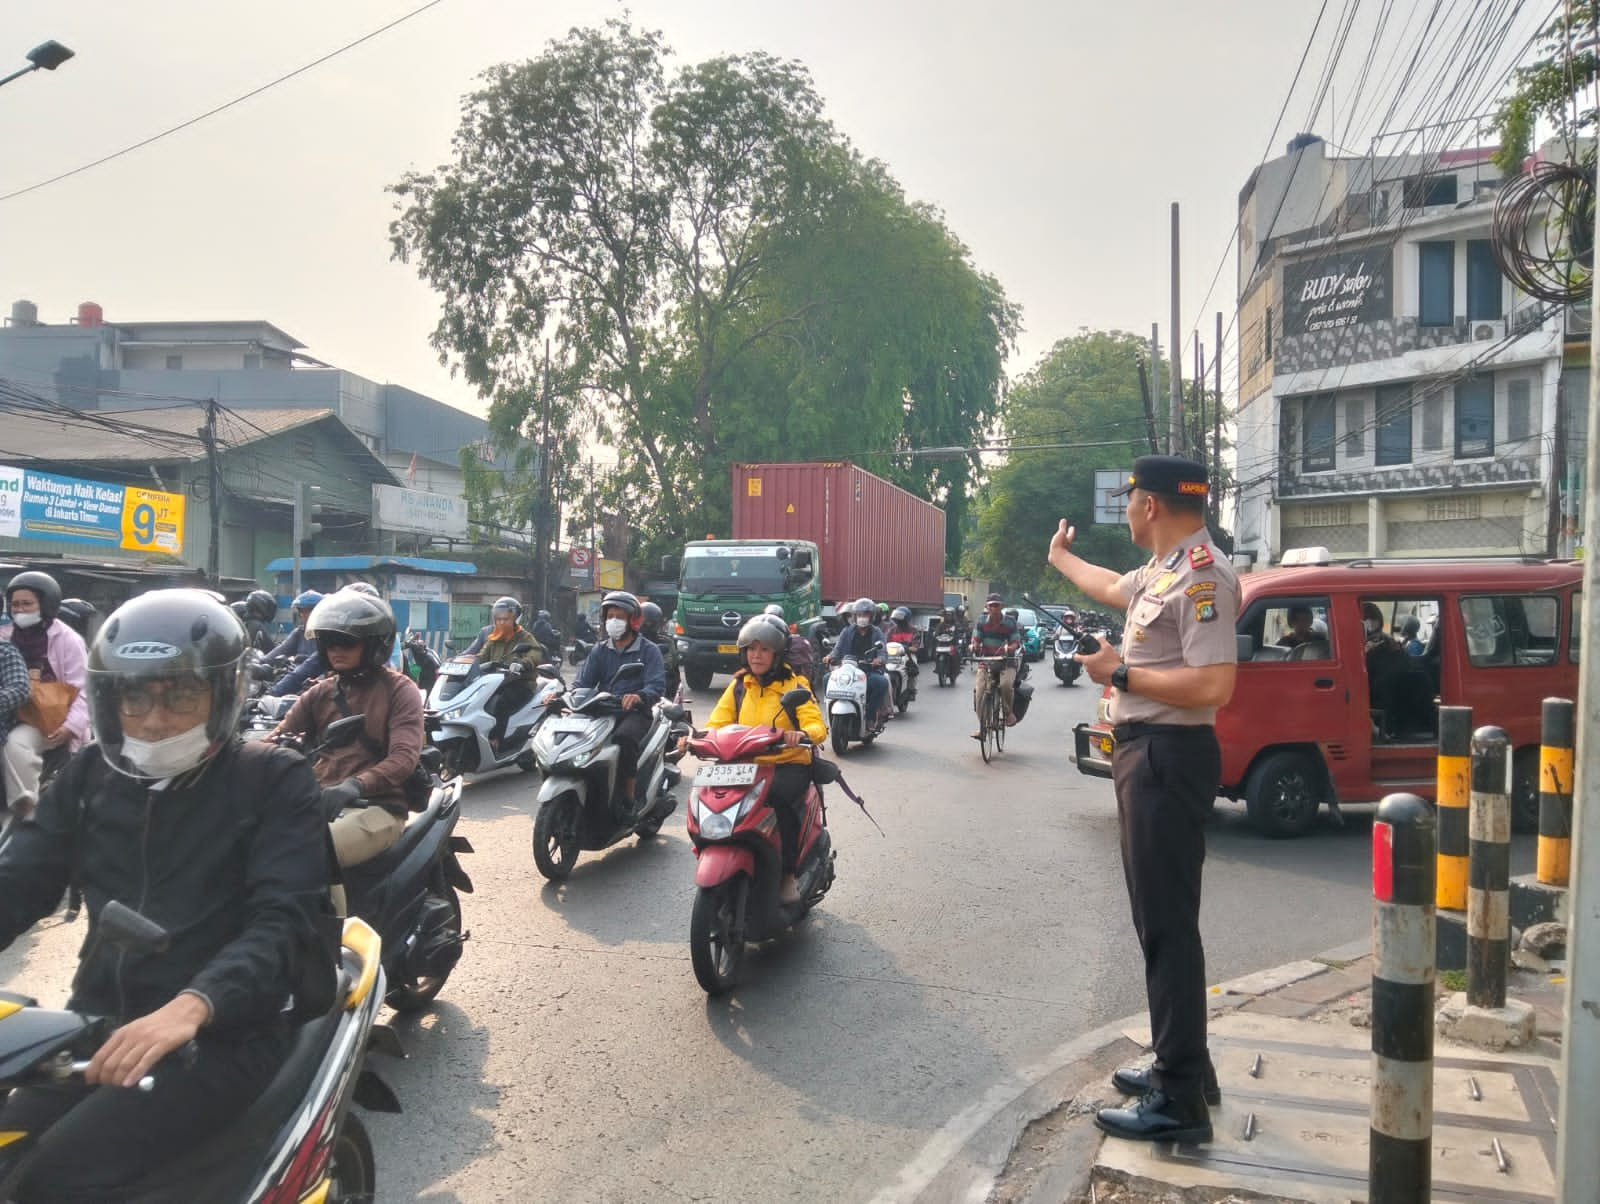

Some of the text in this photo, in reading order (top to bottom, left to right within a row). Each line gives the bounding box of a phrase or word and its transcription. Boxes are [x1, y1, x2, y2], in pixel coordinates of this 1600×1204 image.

[1301, 273, 1345, 302] BUDY
[27, 475, 123, 503] Waktunya Naik Kelas!
[133, 503, 155, 545] 9
[120, 645, 172, 654] INK
